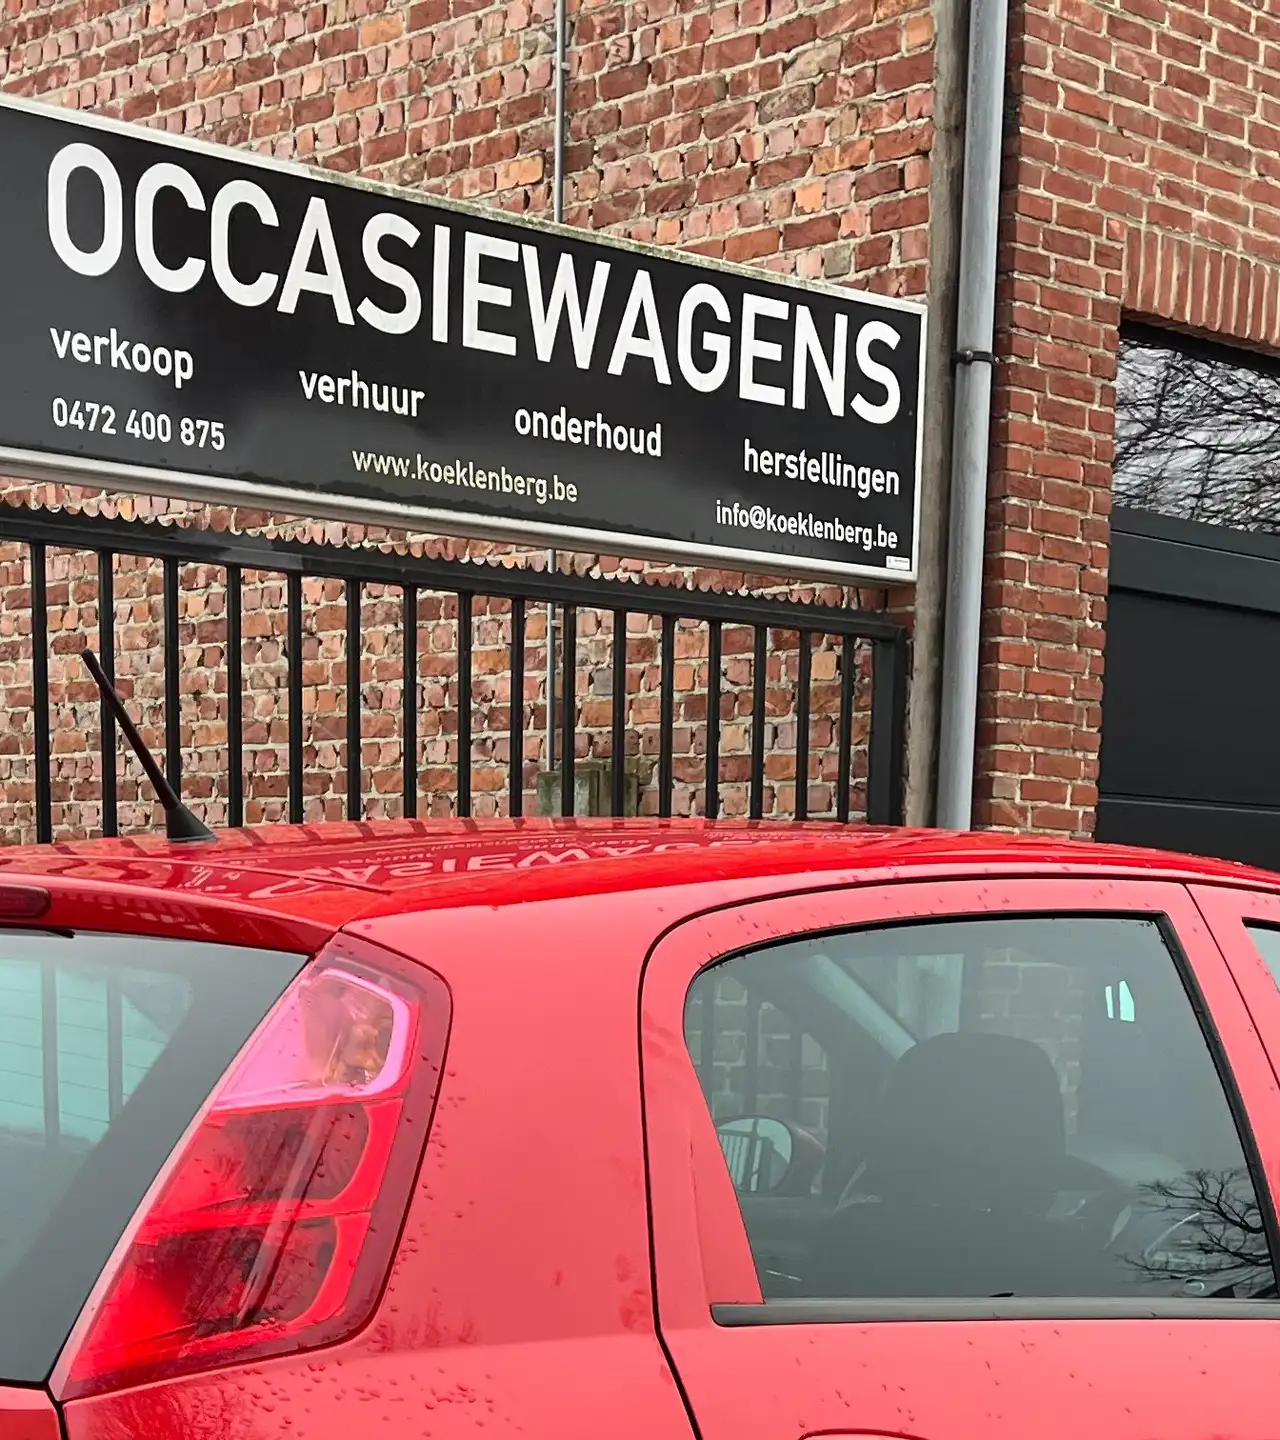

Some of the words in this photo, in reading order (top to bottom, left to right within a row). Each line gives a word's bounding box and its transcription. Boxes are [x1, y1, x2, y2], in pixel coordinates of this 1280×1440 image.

[47, 141, 902, 425] OCCASIEWAGENS
[49, 327, 194, 389] verkoop
[298, 369, 426, 417] verhuur
[52, 397, 117, 435] 0472
[125, 408, 172, 443] 400
[180, 417, 226, 451] 875
[514, 406, 662, 457] onderhoud
[351, 449, 579, 504] www.koeklenberg.be
[743, 438, 900, 499] herstellingen
[715, 499, 899, 549] info@koeklenberg.be
